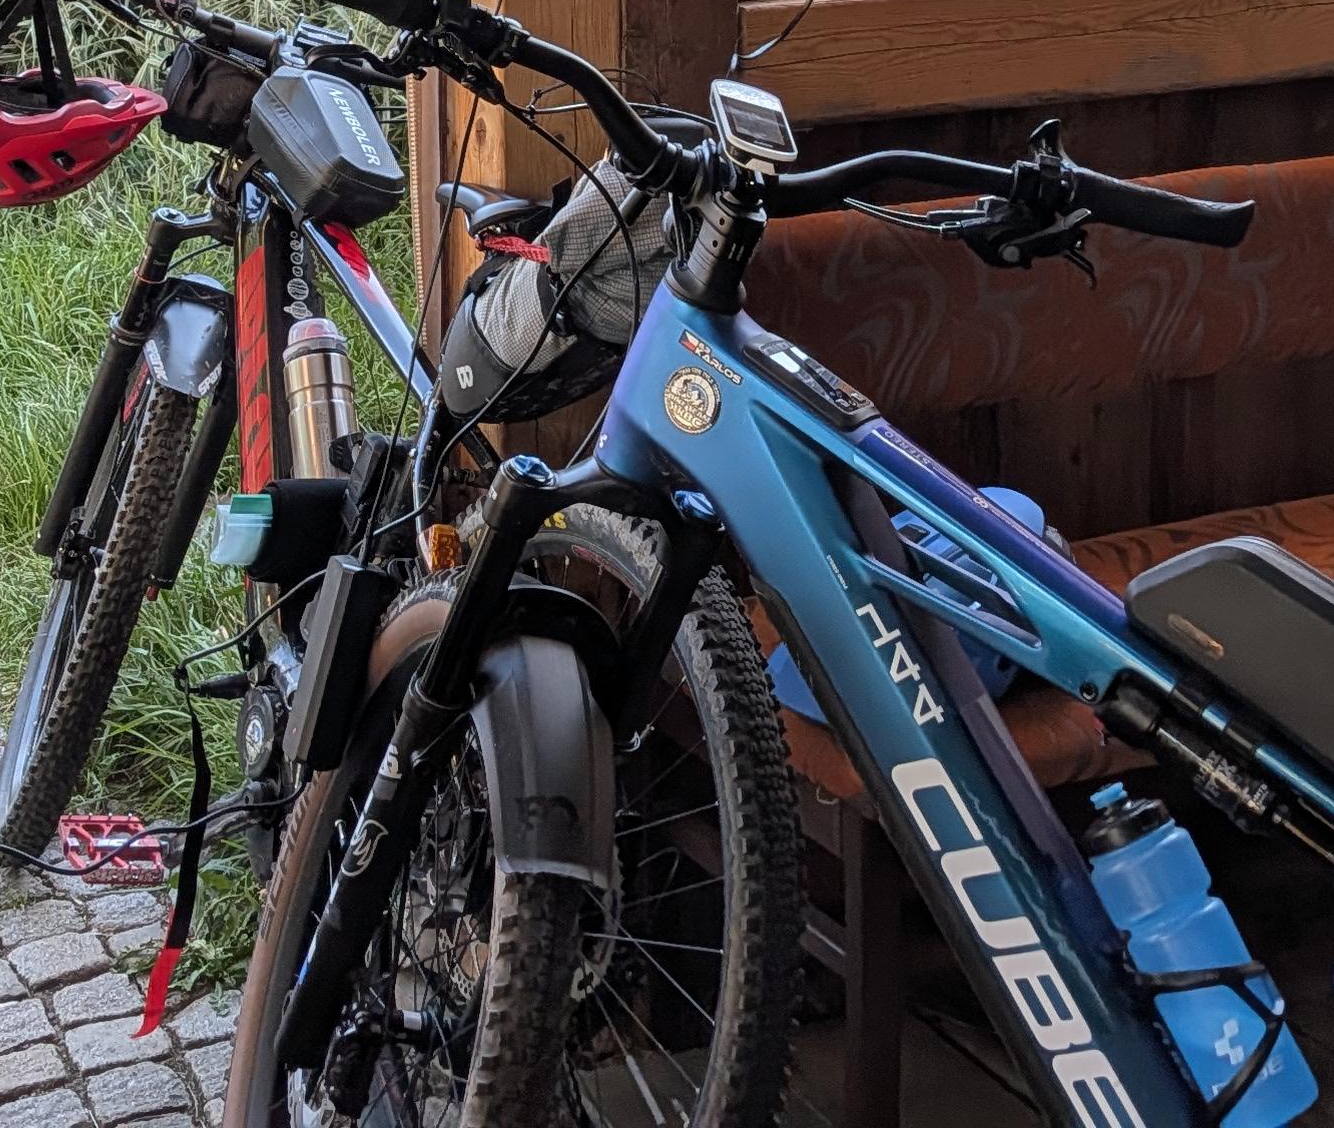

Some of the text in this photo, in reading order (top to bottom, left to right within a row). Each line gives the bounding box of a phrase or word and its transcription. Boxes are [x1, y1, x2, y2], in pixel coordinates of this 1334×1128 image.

[325, 87, 381, 166] NEWBOLER
[694, 347, 742, 385] KARLOS
[891, 758, 1147, 1128] CUBE
